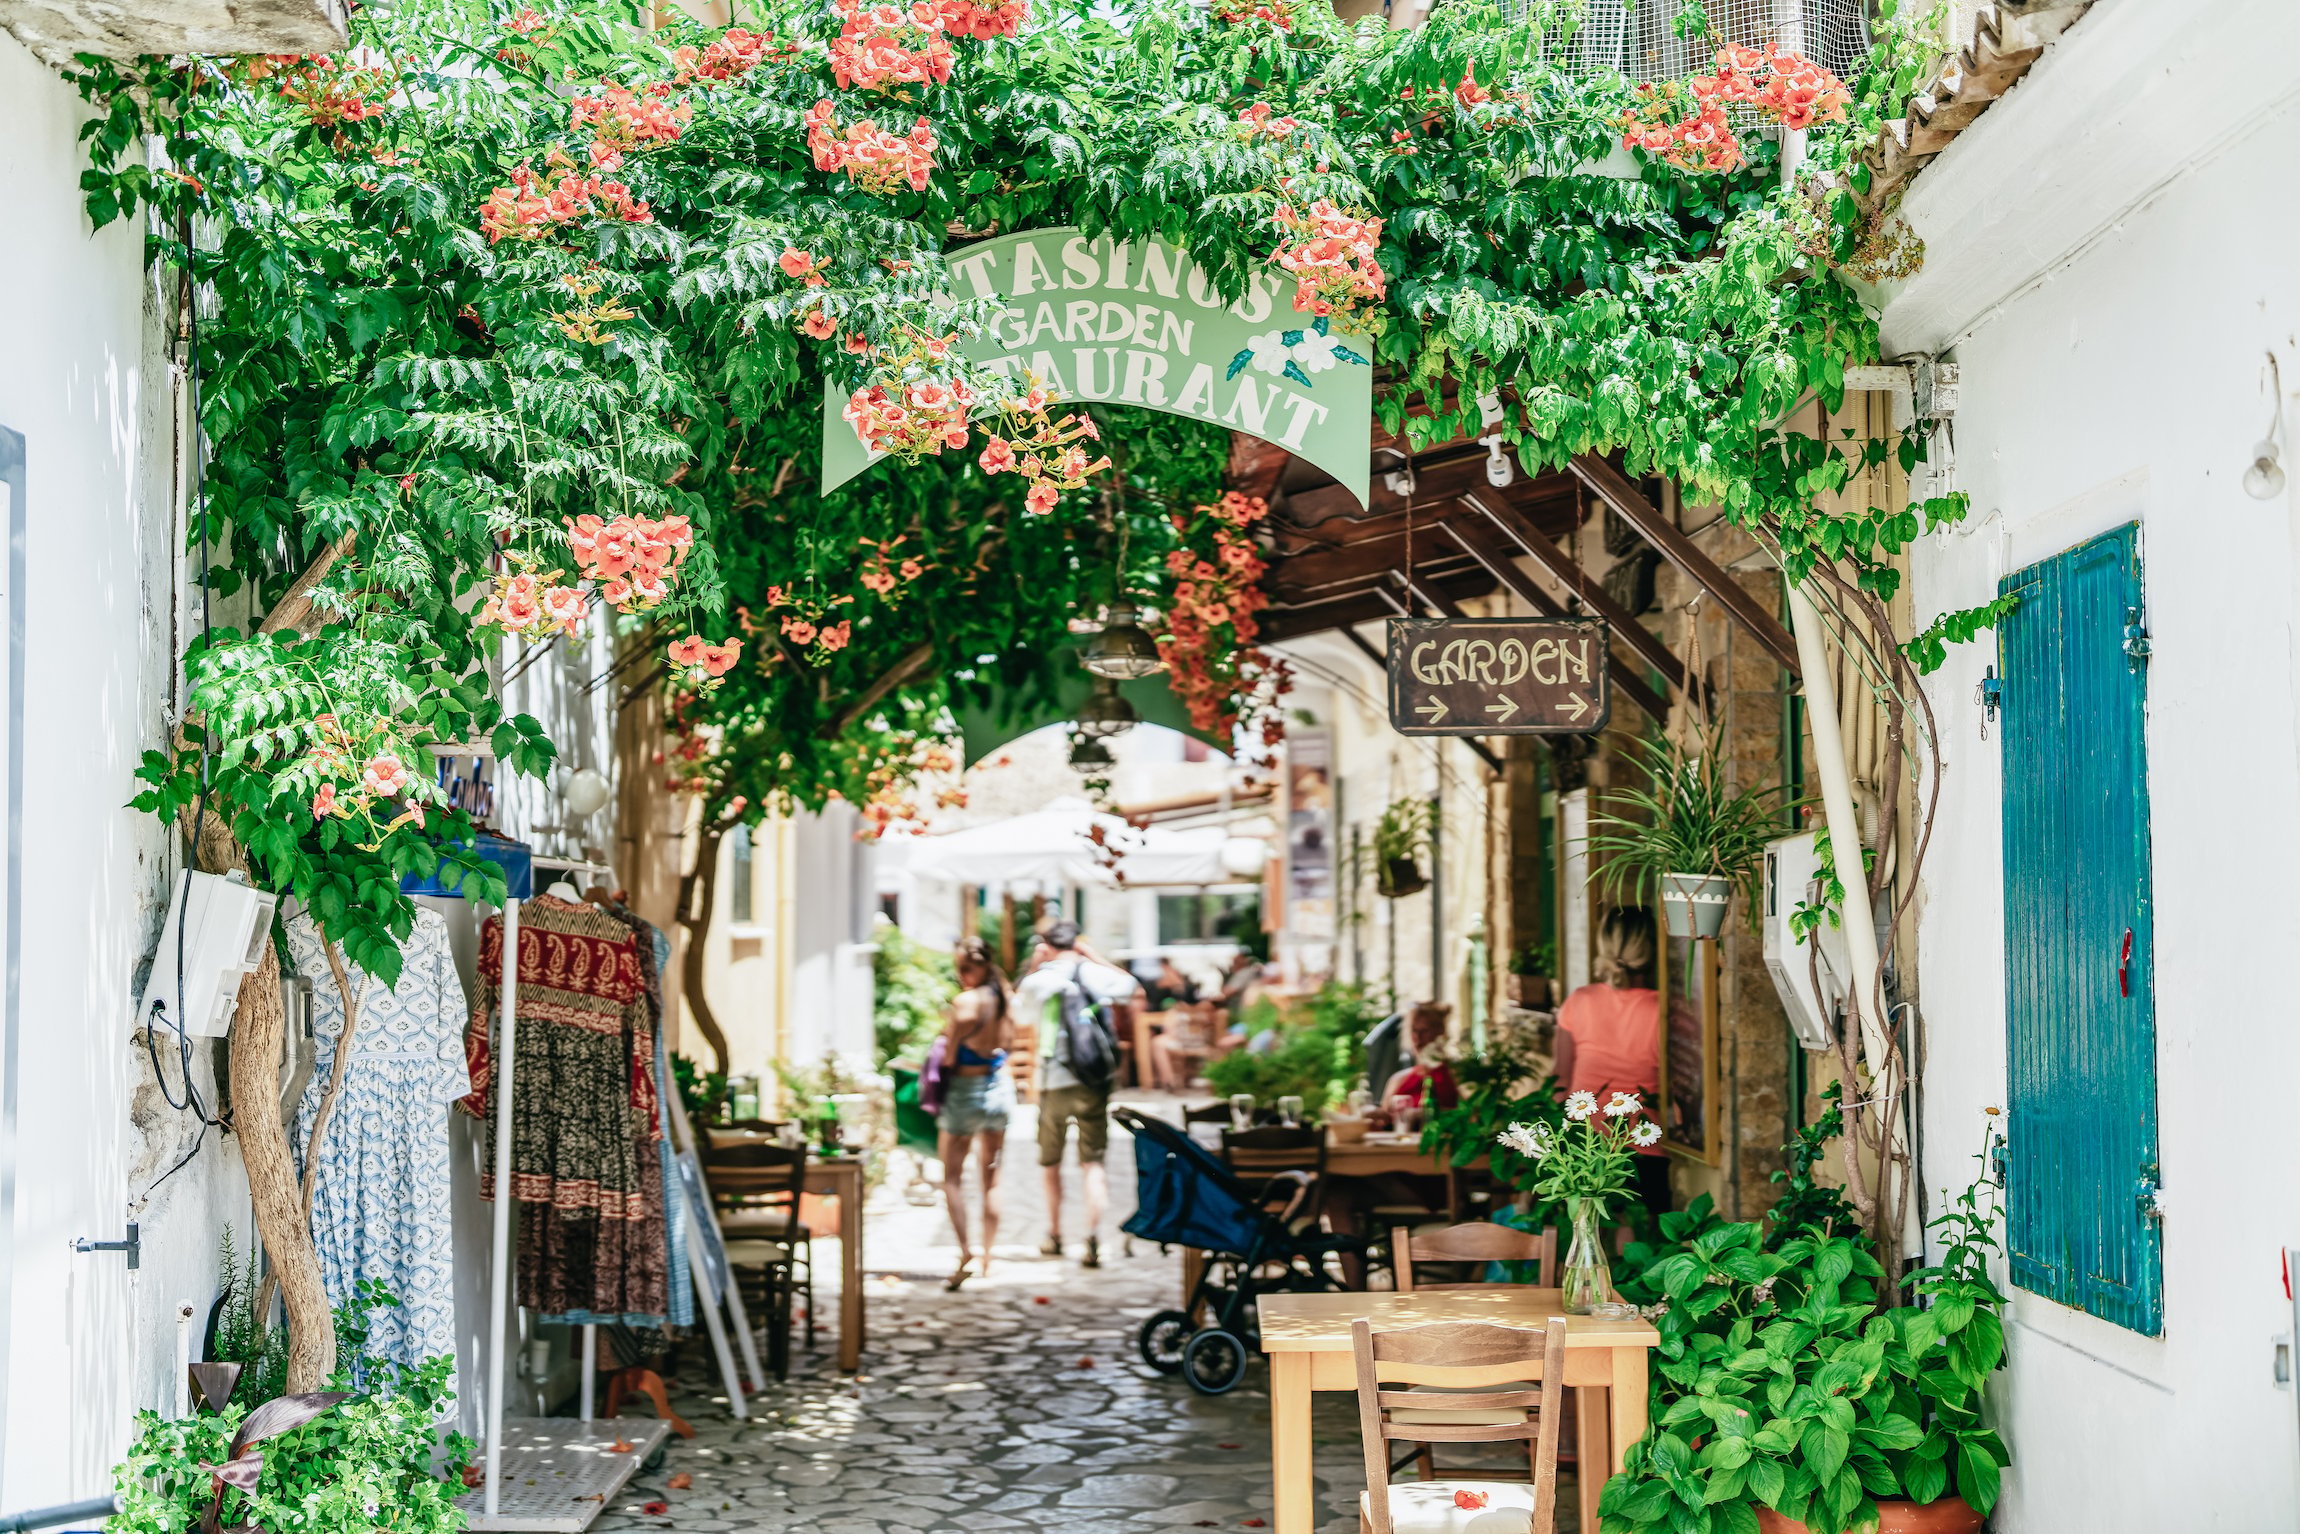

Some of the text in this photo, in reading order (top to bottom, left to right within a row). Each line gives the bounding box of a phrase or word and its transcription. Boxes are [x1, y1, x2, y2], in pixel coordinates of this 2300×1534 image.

[989, 299, 1195, 357] GARDEN
[848, 347, 1330, 462] TAURANT
[1409, 637, 1592, 686] GARDEN
